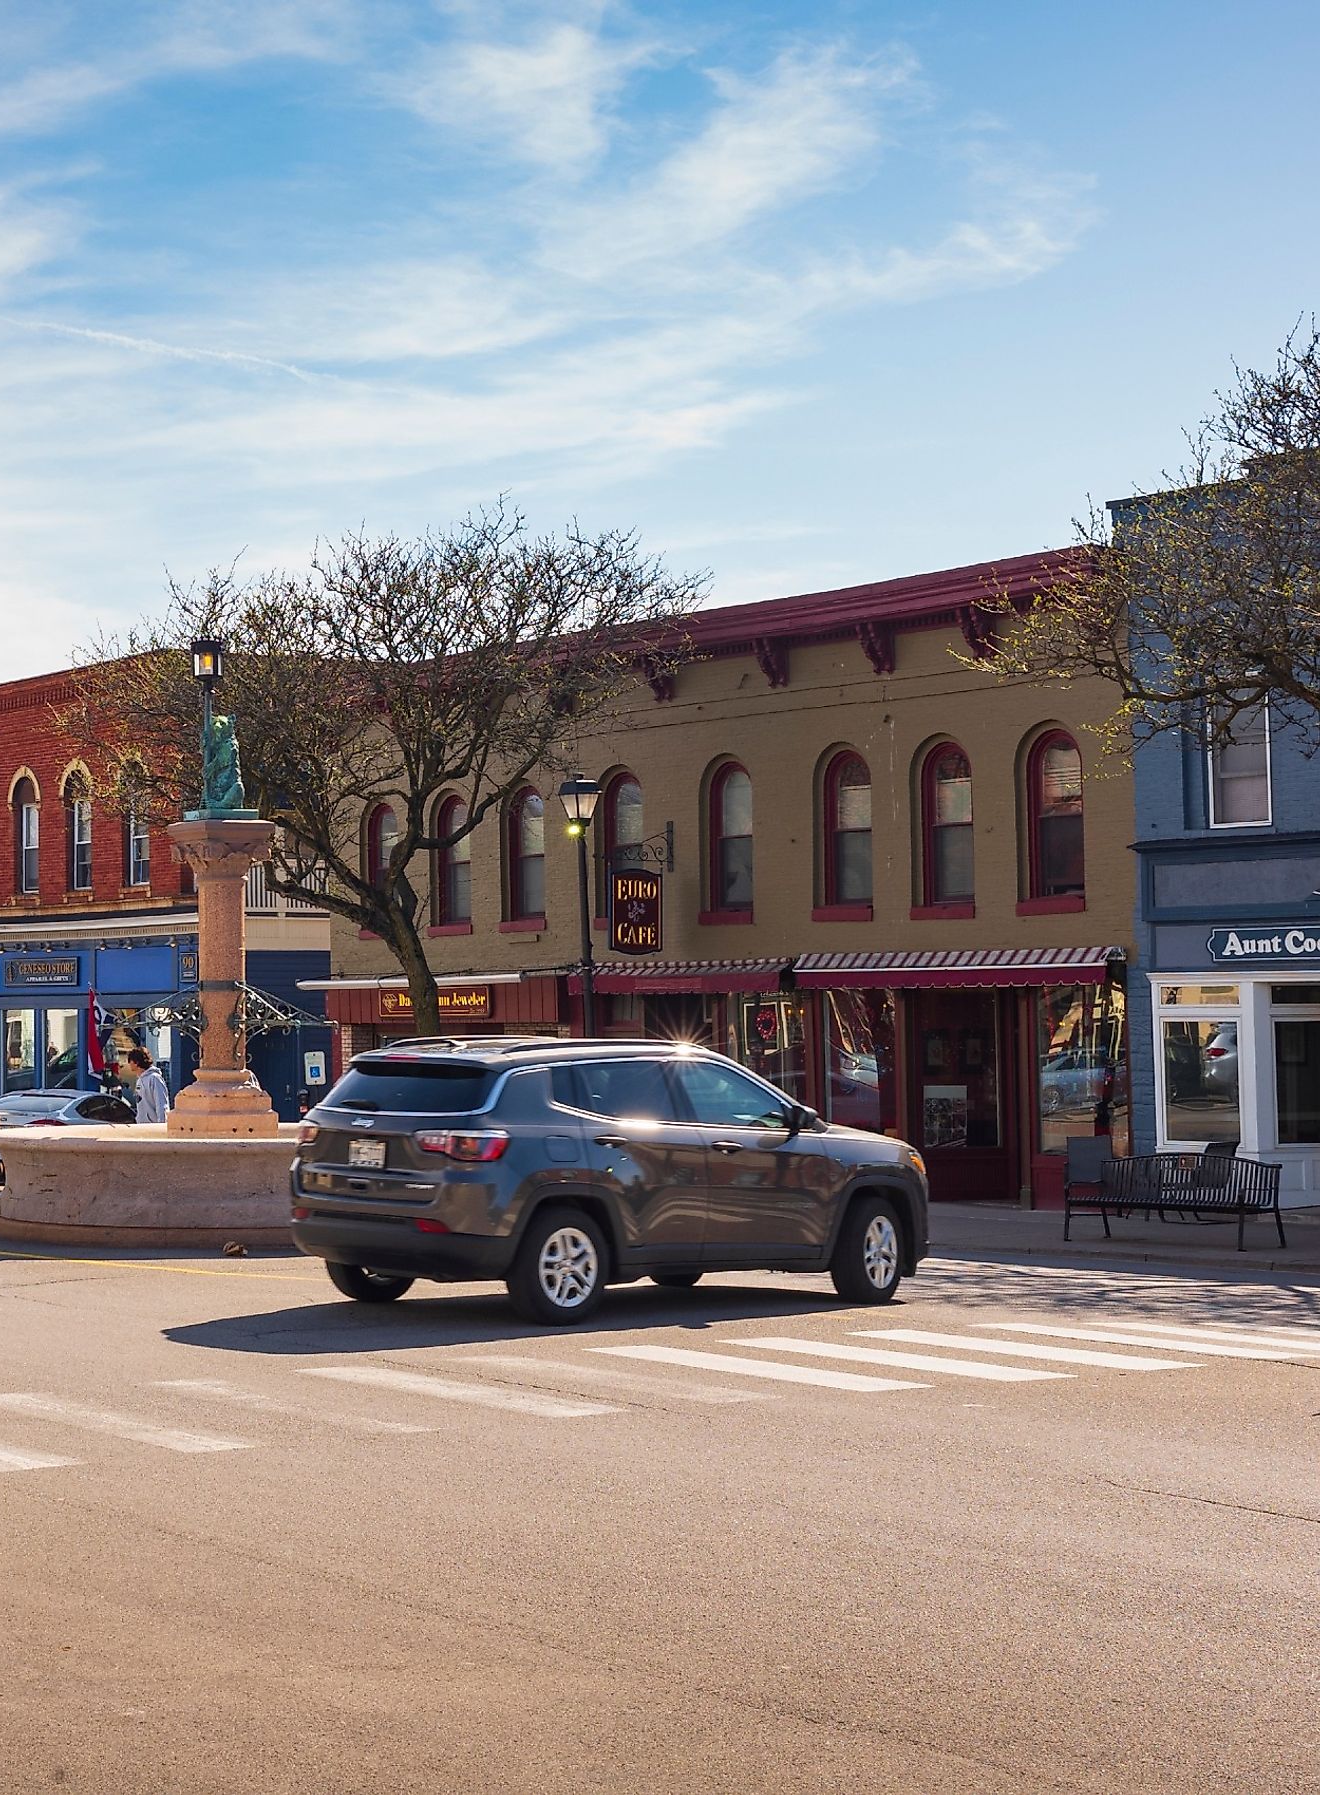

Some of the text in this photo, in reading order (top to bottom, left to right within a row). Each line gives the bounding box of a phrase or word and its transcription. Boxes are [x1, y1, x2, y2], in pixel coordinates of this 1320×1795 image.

[617, 879, 657, 900] EURO
[617, 922, 656, 946] CAFÉ
[1221, 930, 1320, 956] Aunt Co
[18, 961, 74, 975] GENESEO STORE
[182, 956, 194, 969] 90
[451, 992, 486, 1006] Jeweler
